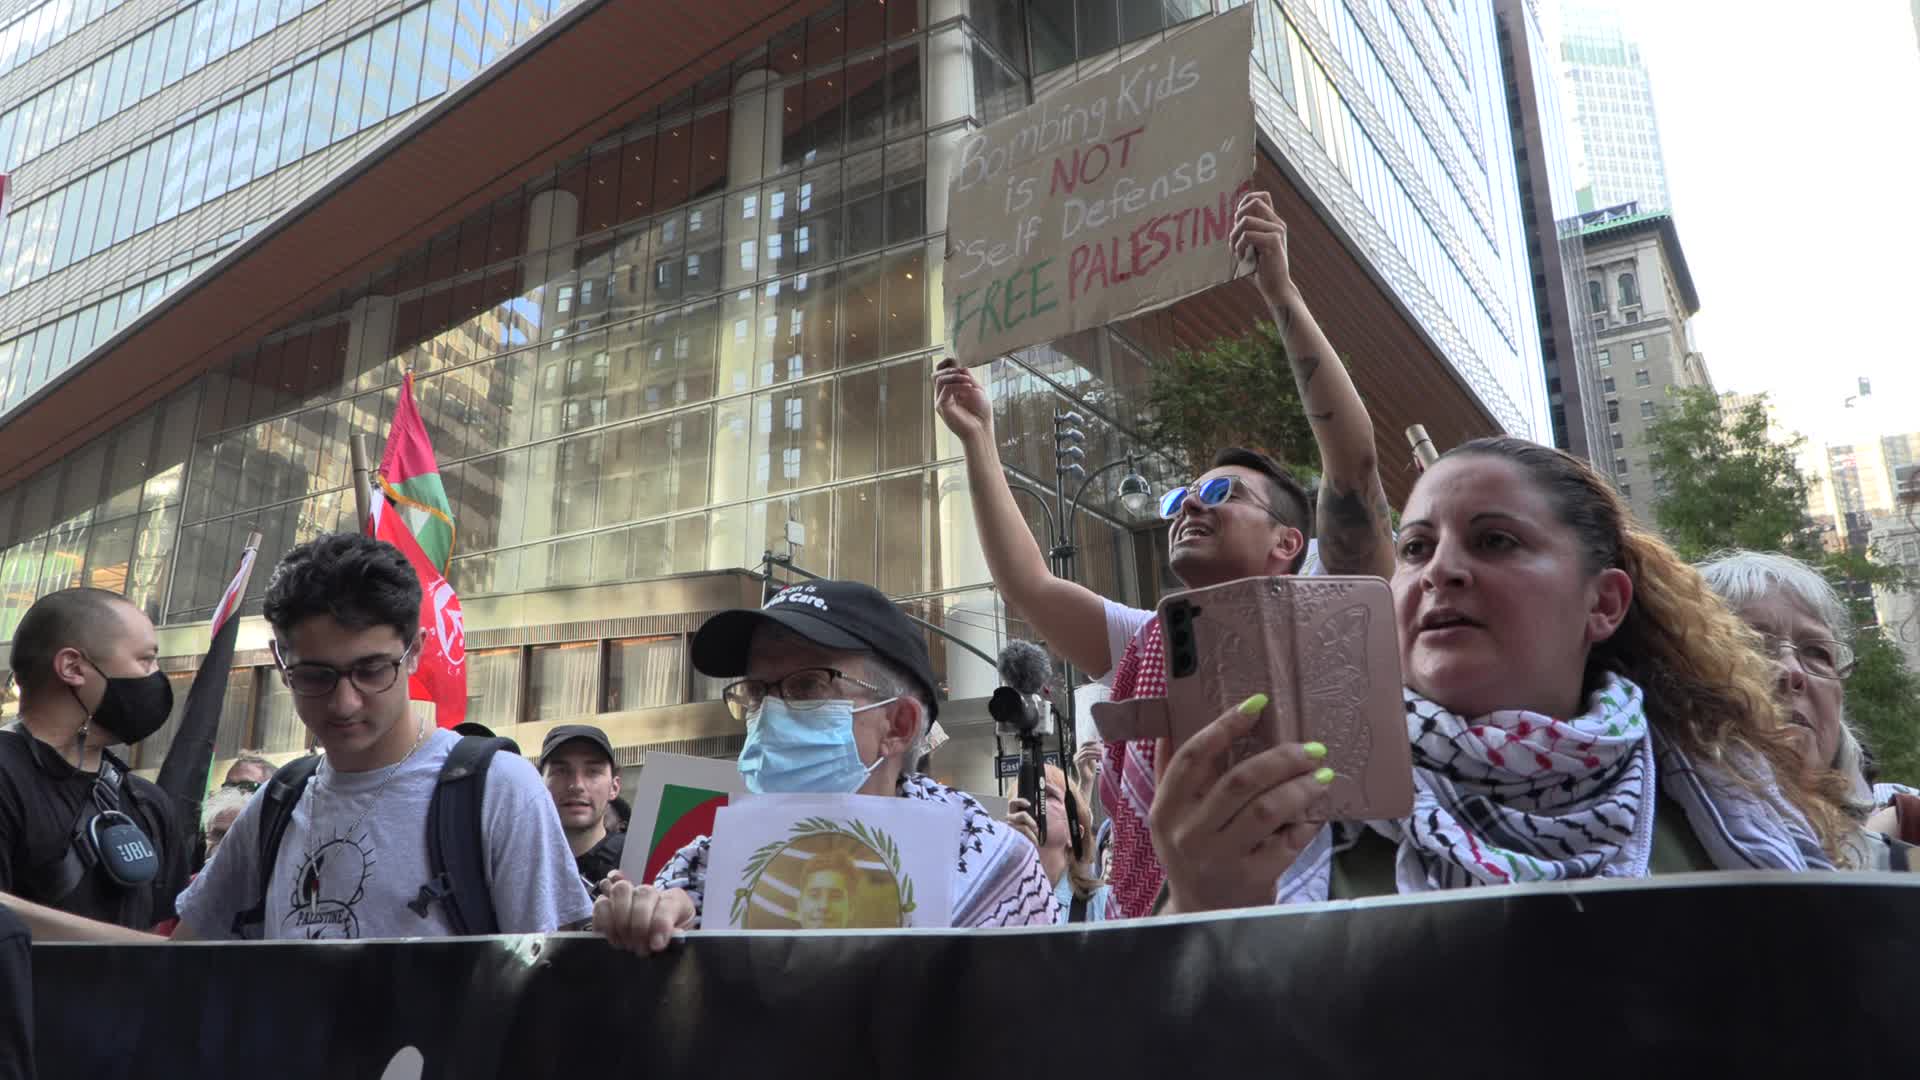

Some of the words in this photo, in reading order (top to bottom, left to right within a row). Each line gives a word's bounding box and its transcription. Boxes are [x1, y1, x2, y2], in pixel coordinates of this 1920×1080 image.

[958, 100, 1107, 192] Bombing
[1117, 56, 1200, 119] Kids
[1005, 175, 1039, 216] is
[1050, 127, 1145, 197] NOT
[952, 256, 1058, 351] FREE
[788, 592, 828, 611] Care.
[1001, 761, 1020, 773] East
[116, 841, 153, 862] JBL
